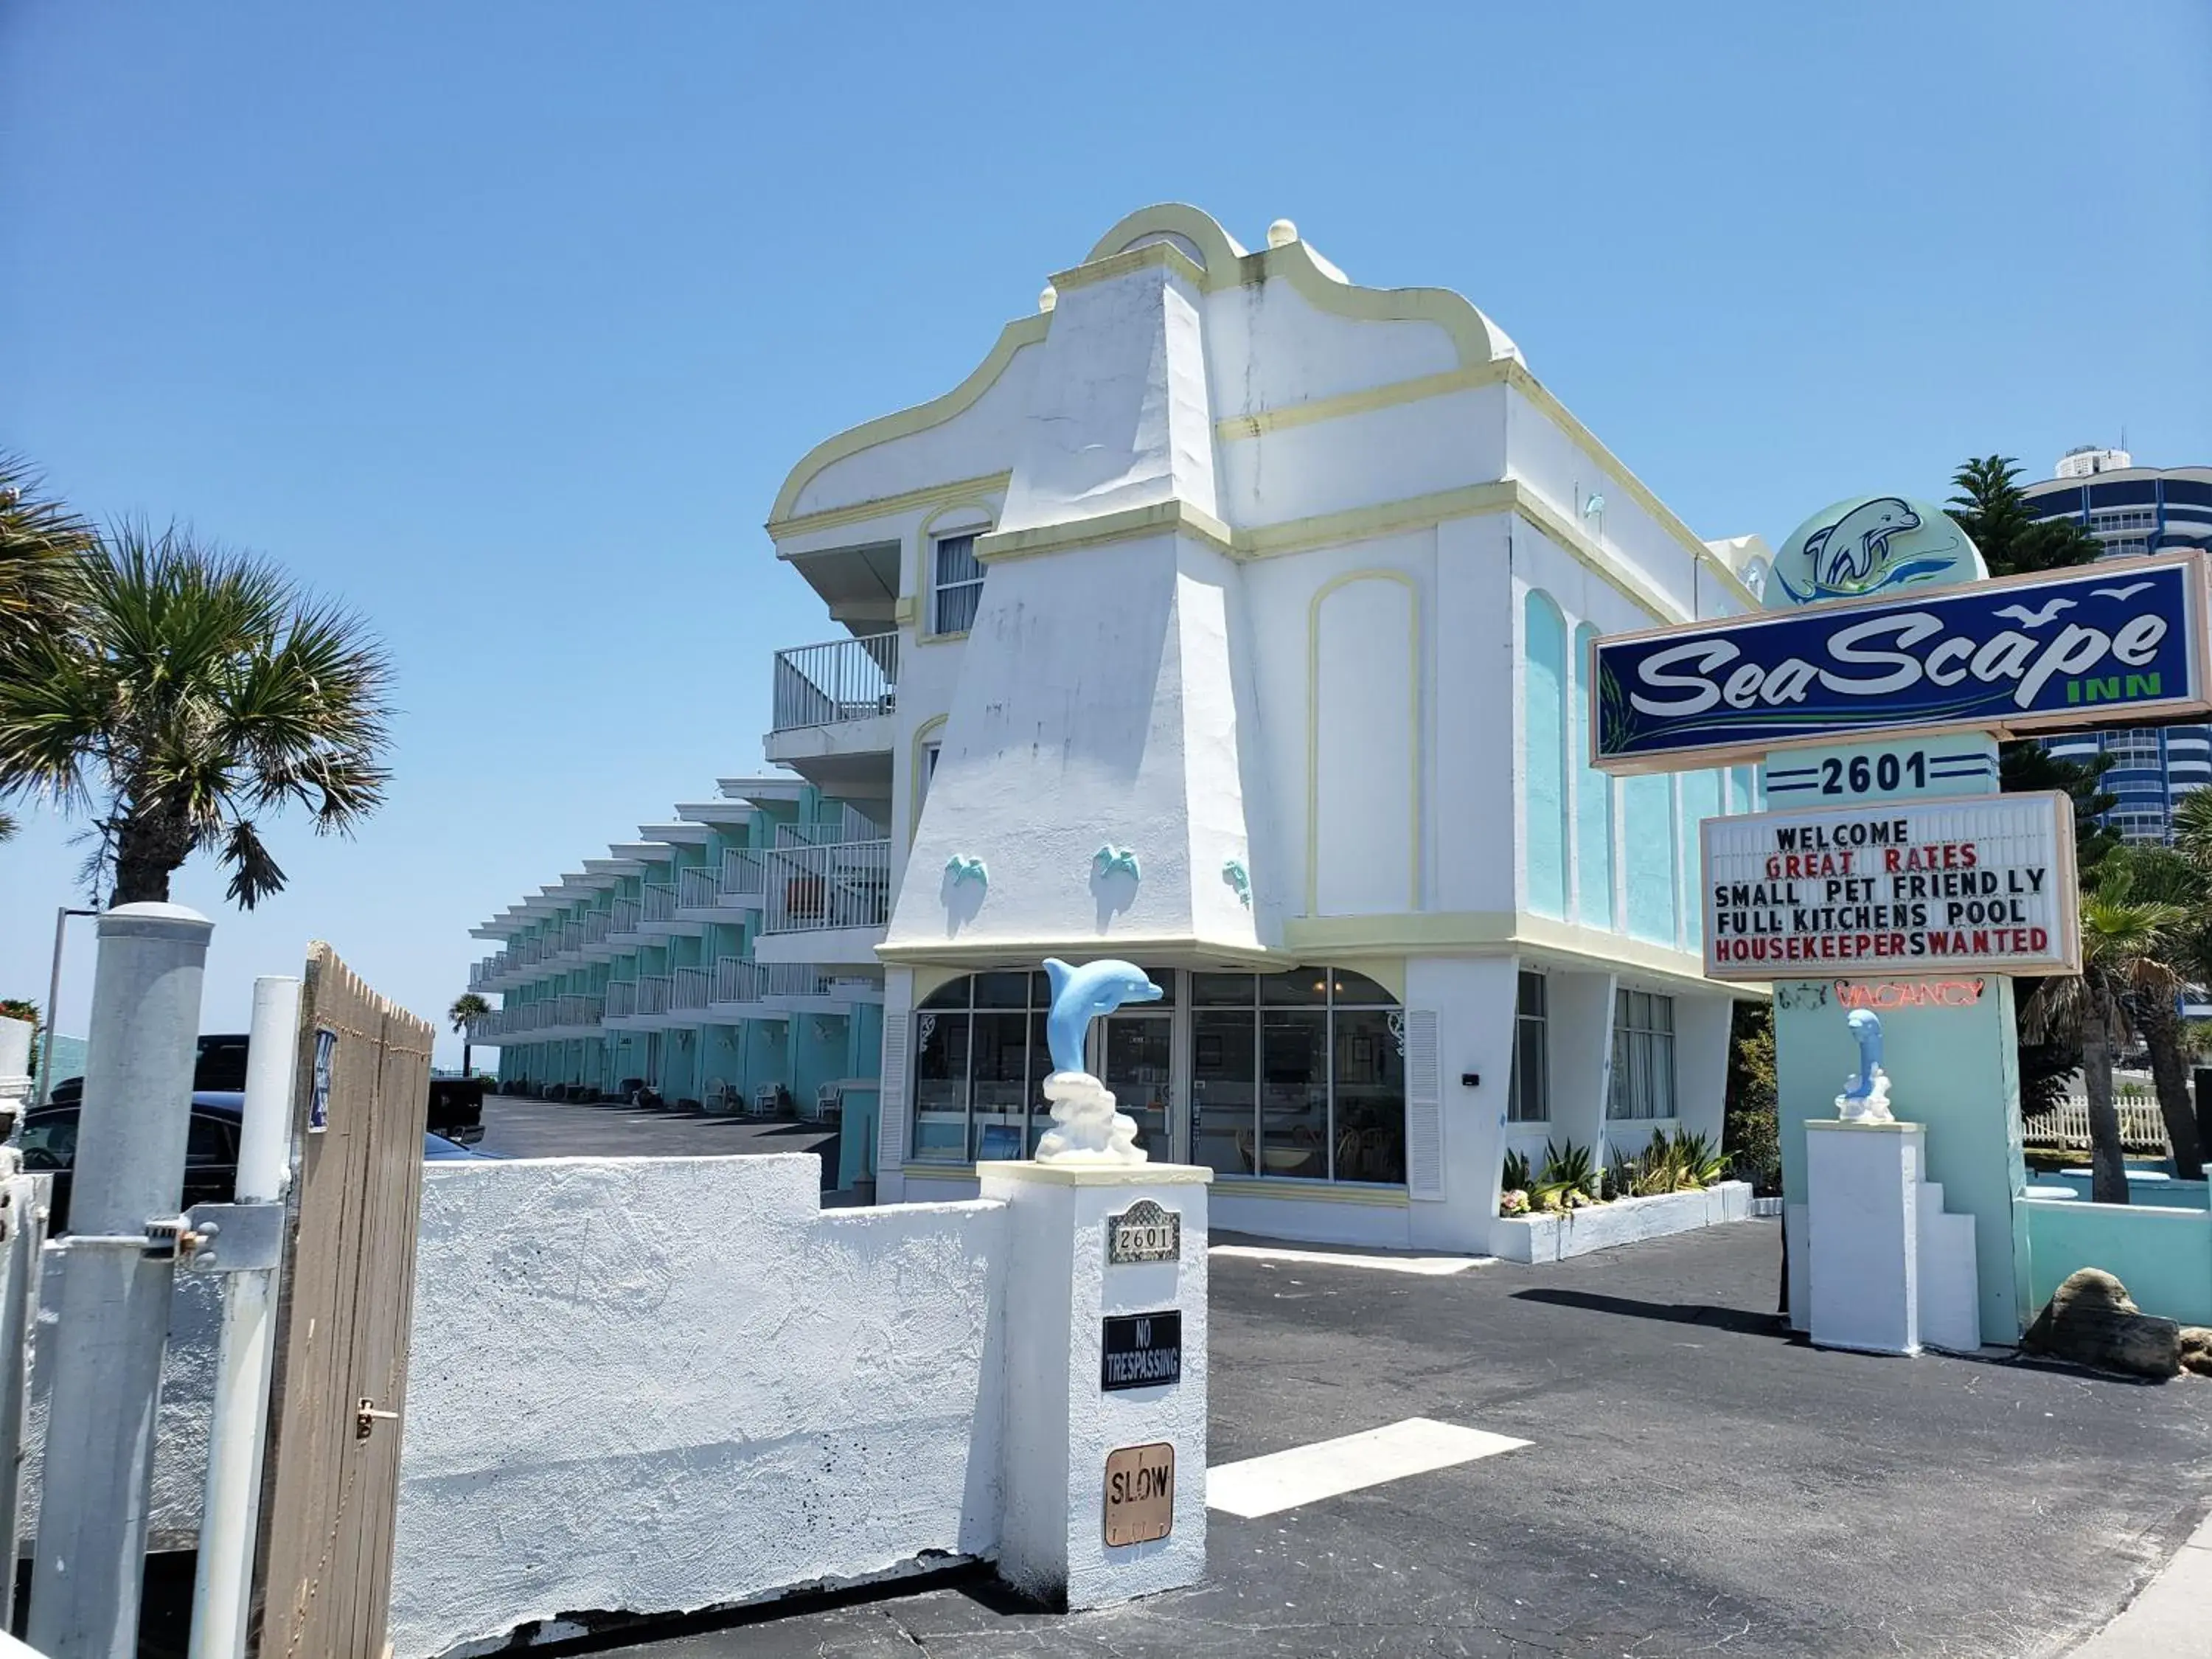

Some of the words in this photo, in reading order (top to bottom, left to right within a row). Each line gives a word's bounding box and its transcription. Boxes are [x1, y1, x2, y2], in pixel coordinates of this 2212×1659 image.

[2067, 671, 2161, 704] INN
[1822, 751, 1925, 795] 2601
[1777, 820, 1908, 849] WELCOME
[1766, 851, 1853, 880] GREAT
[1884, 843, 1978, 873] RATES
[1715, 883, 1800, 908] SMALL
[1826, 877, 1876, 902] PET
[1893, 869, 2045, 899] FRIENDLY
[1717, 909, 1782, 934] FULL
[1793, 904, 1927, 931] KITCHENS
[1947, 899, 2026, 925] POOL
[1715, 932, 1926, 960] HOUSEKEEPERS
[1927, 928, 2048, 954] WANTED
[1834, 978, 1985, 1007] VACANCY
[1121, 1228, 1167, 1249] 2601
[1136, 1318, 1151, 1349] NO
[1107, 1347, 1178, 1382] TRESPASSING
[1111, 1465, 1169, 1505] SLOW
